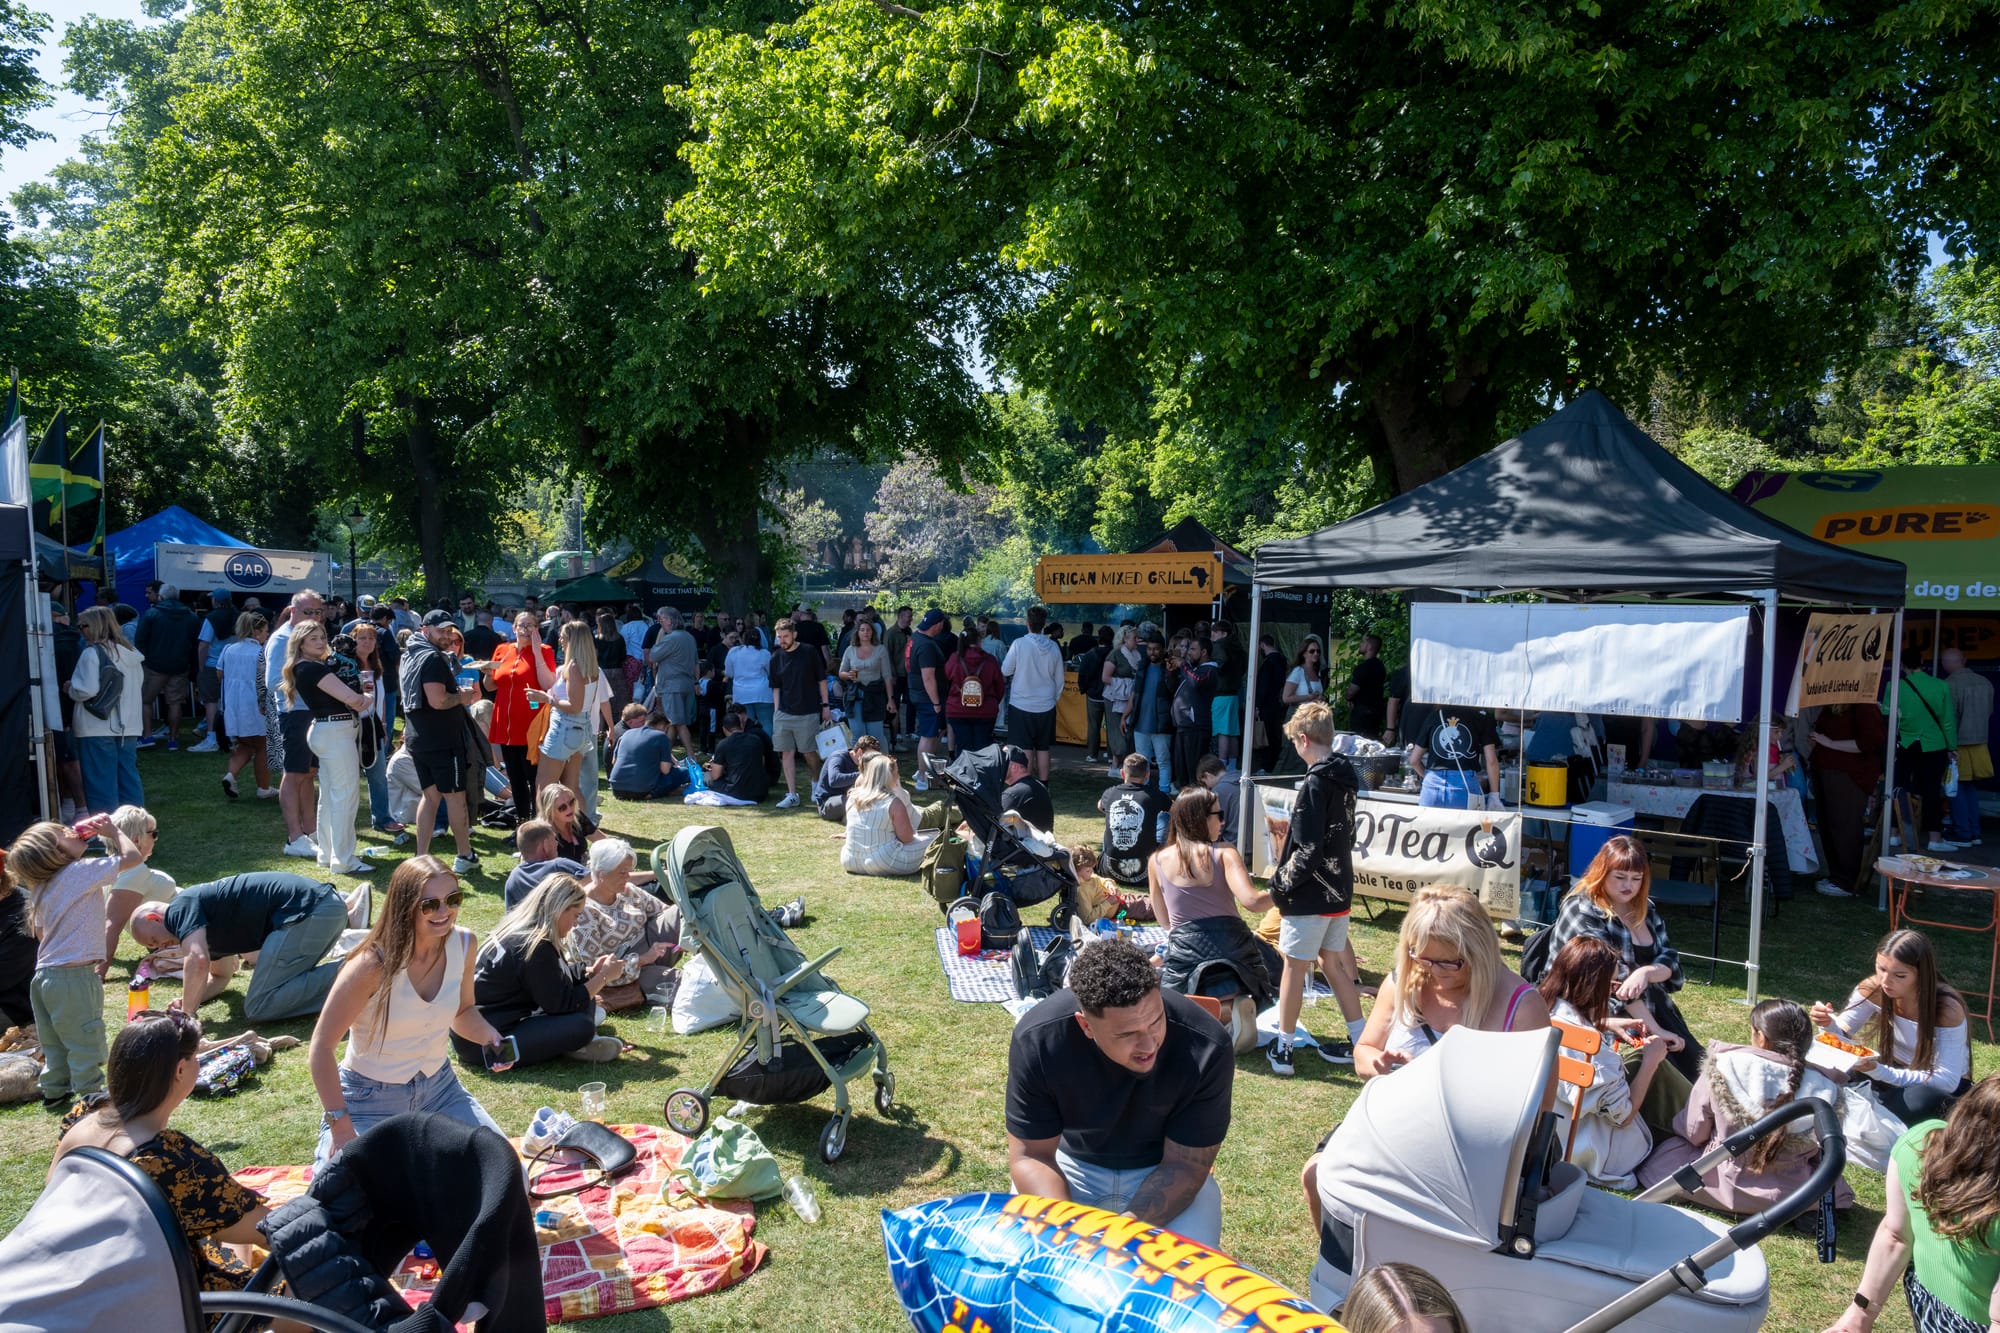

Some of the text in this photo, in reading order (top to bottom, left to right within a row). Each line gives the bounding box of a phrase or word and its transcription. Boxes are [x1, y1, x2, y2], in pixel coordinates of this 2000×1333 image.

[1824, 512, 1963, 539] PURE
[233, 563, 264, 577] BAR
[1046, 571, 1193, 586] AFRICAN MIXED GRILL
[652, 587, 677, 595] CHEESE
[678, 587, 693, 595] THAT
[1914, 581, 2000, 600] dog de
[1352, 872, 1378, 887] bble
[1381, 876, 1403, 891] Tea
[1406, 880, 1417, 893] @
